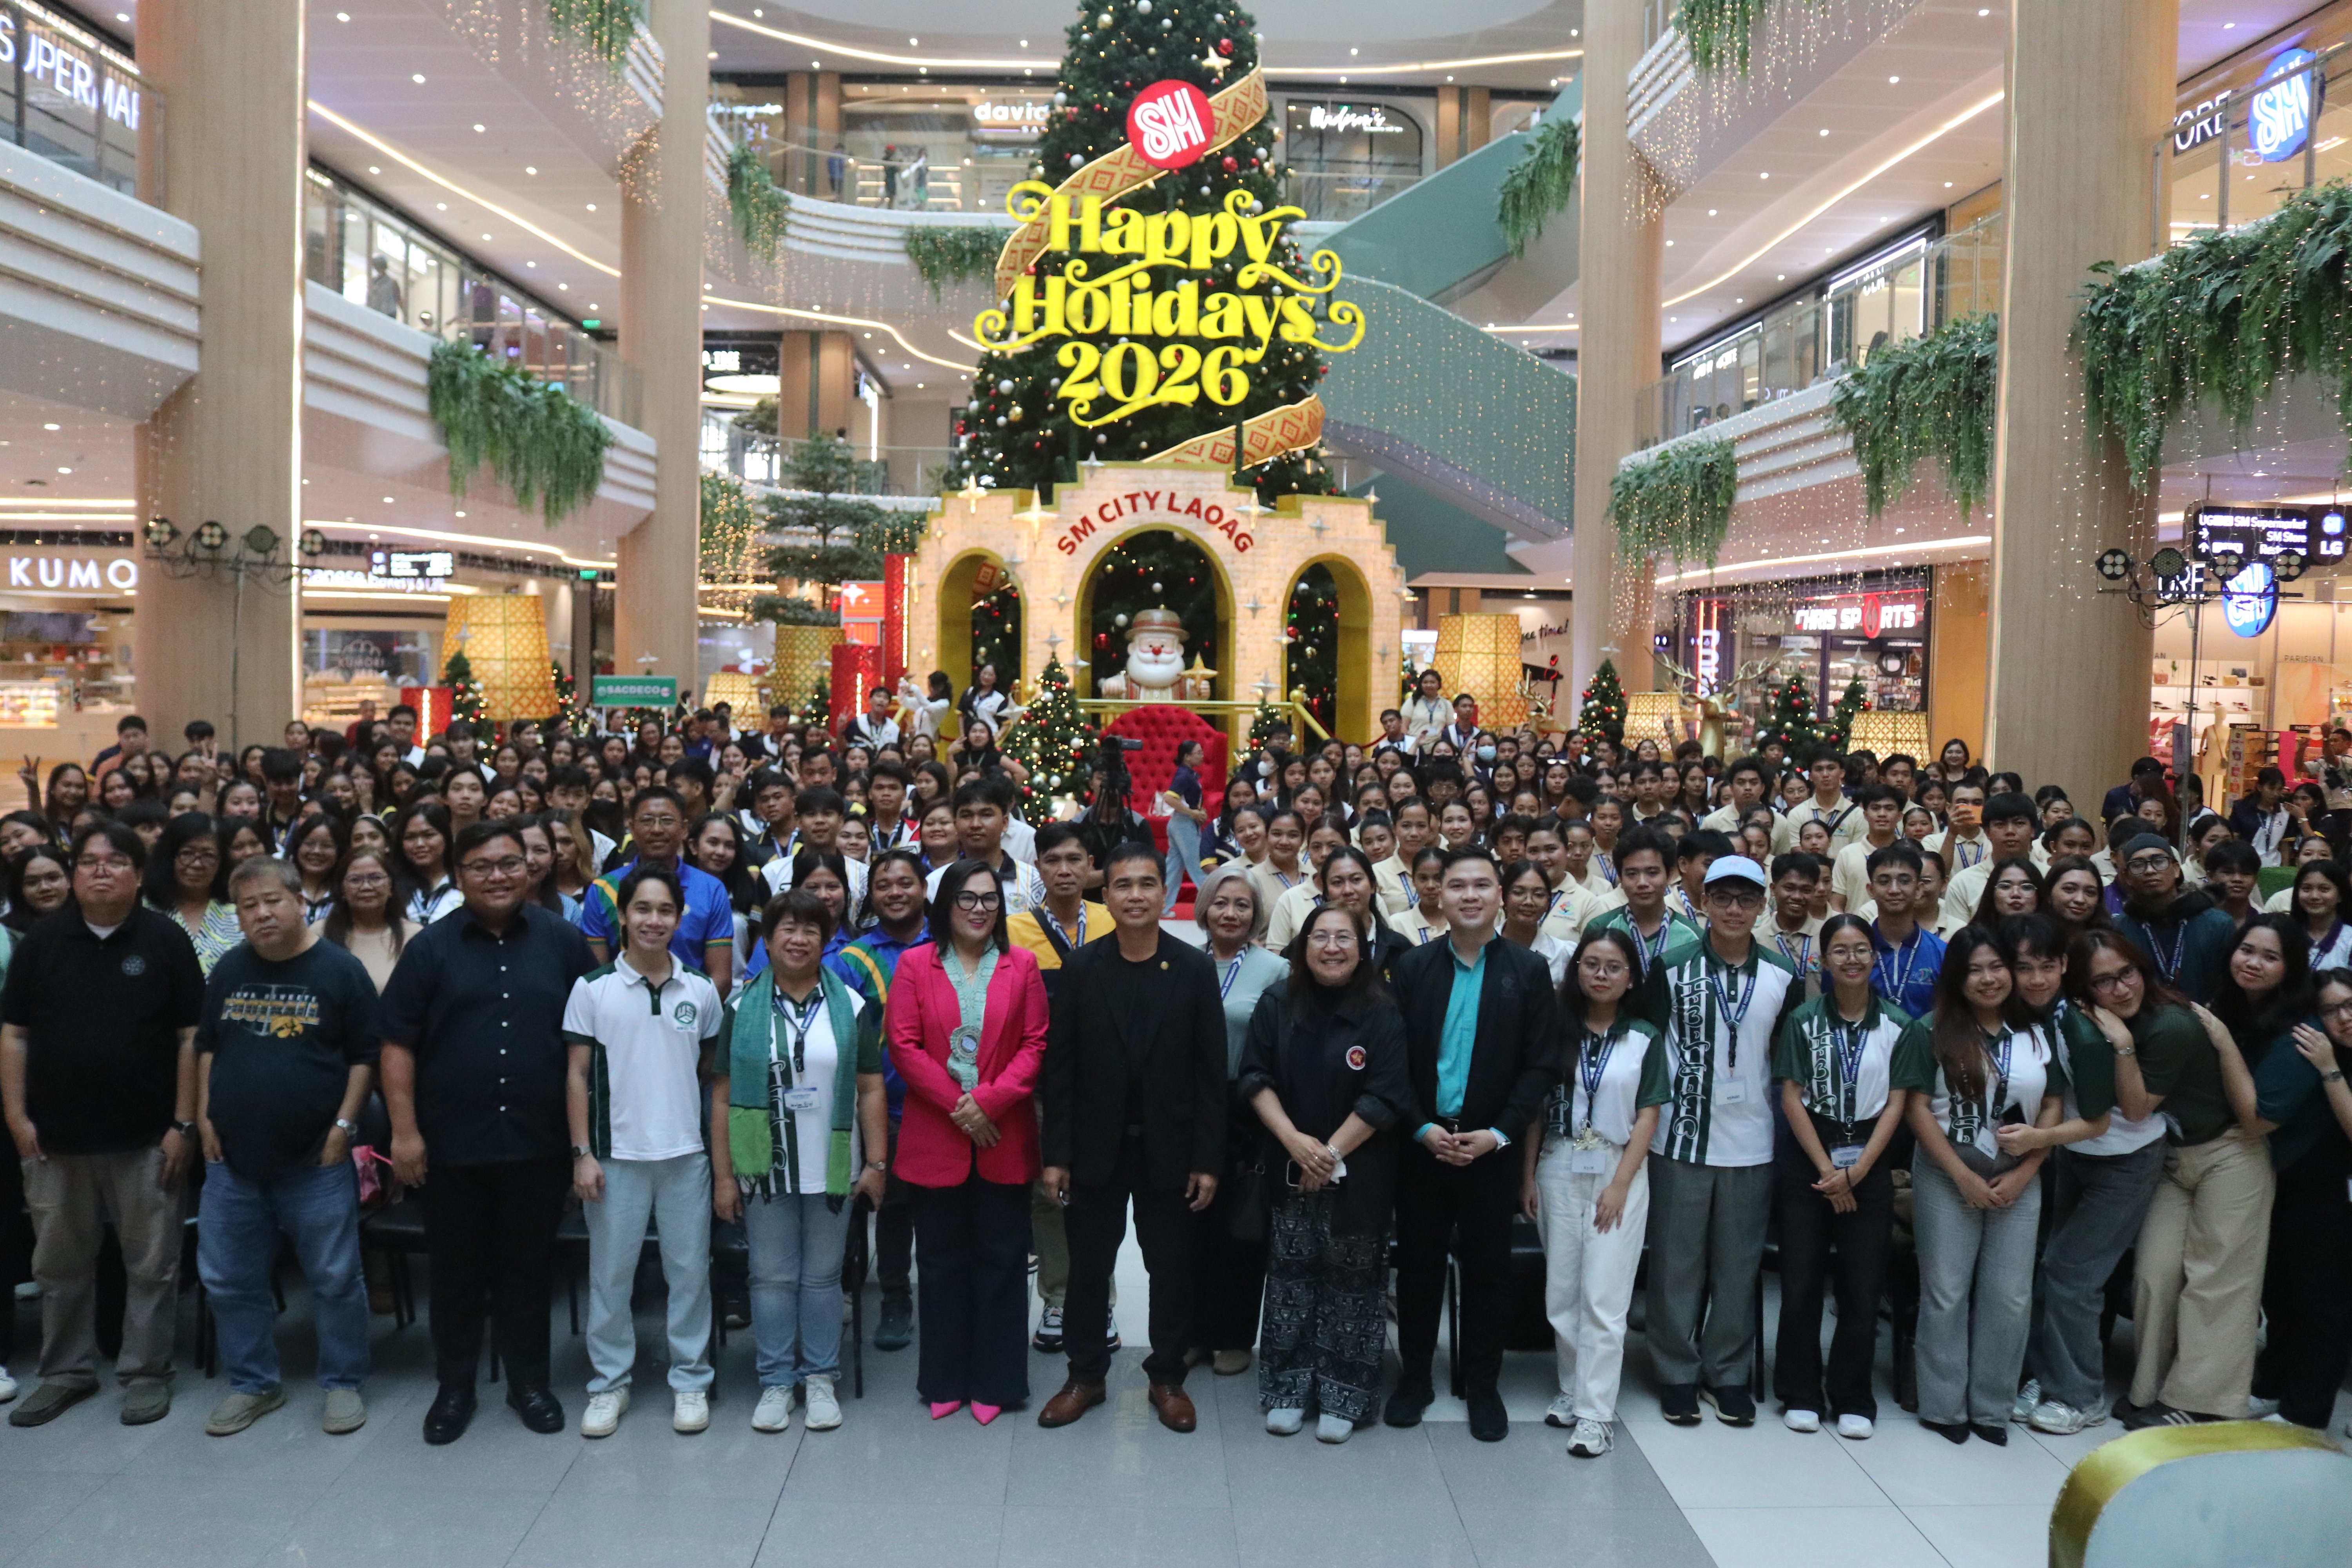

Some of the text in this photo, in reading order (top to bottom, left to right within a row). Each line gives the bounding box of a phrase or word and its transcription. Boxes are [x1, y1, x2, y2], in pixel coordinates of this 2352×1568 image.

[1134, 88, 1205, 160] SM
[2174, 90, 2232, 150] ORE
[2253, 56, 2309, 154] SM
[1006, 180, 1342, 293] Happy
[975, 270, 1365, 363] Holidays
[1057, 341, 1250, 426] 2026
[1057, 490, 1254, 556] SM CITY LAOAG
[2234, 516, 2250, 527] SM
[2251, 516, 2308, 530] Supermarket
[2267, 531, 2308, 543] SM Store
[2320, 541, 2344, 555] LG
[10, 557, 138, 589] KUMO
[1795, 594, 1916, 639] CHRIS SPORTS
[1743, 990, 1751, 1004] YOUTH
